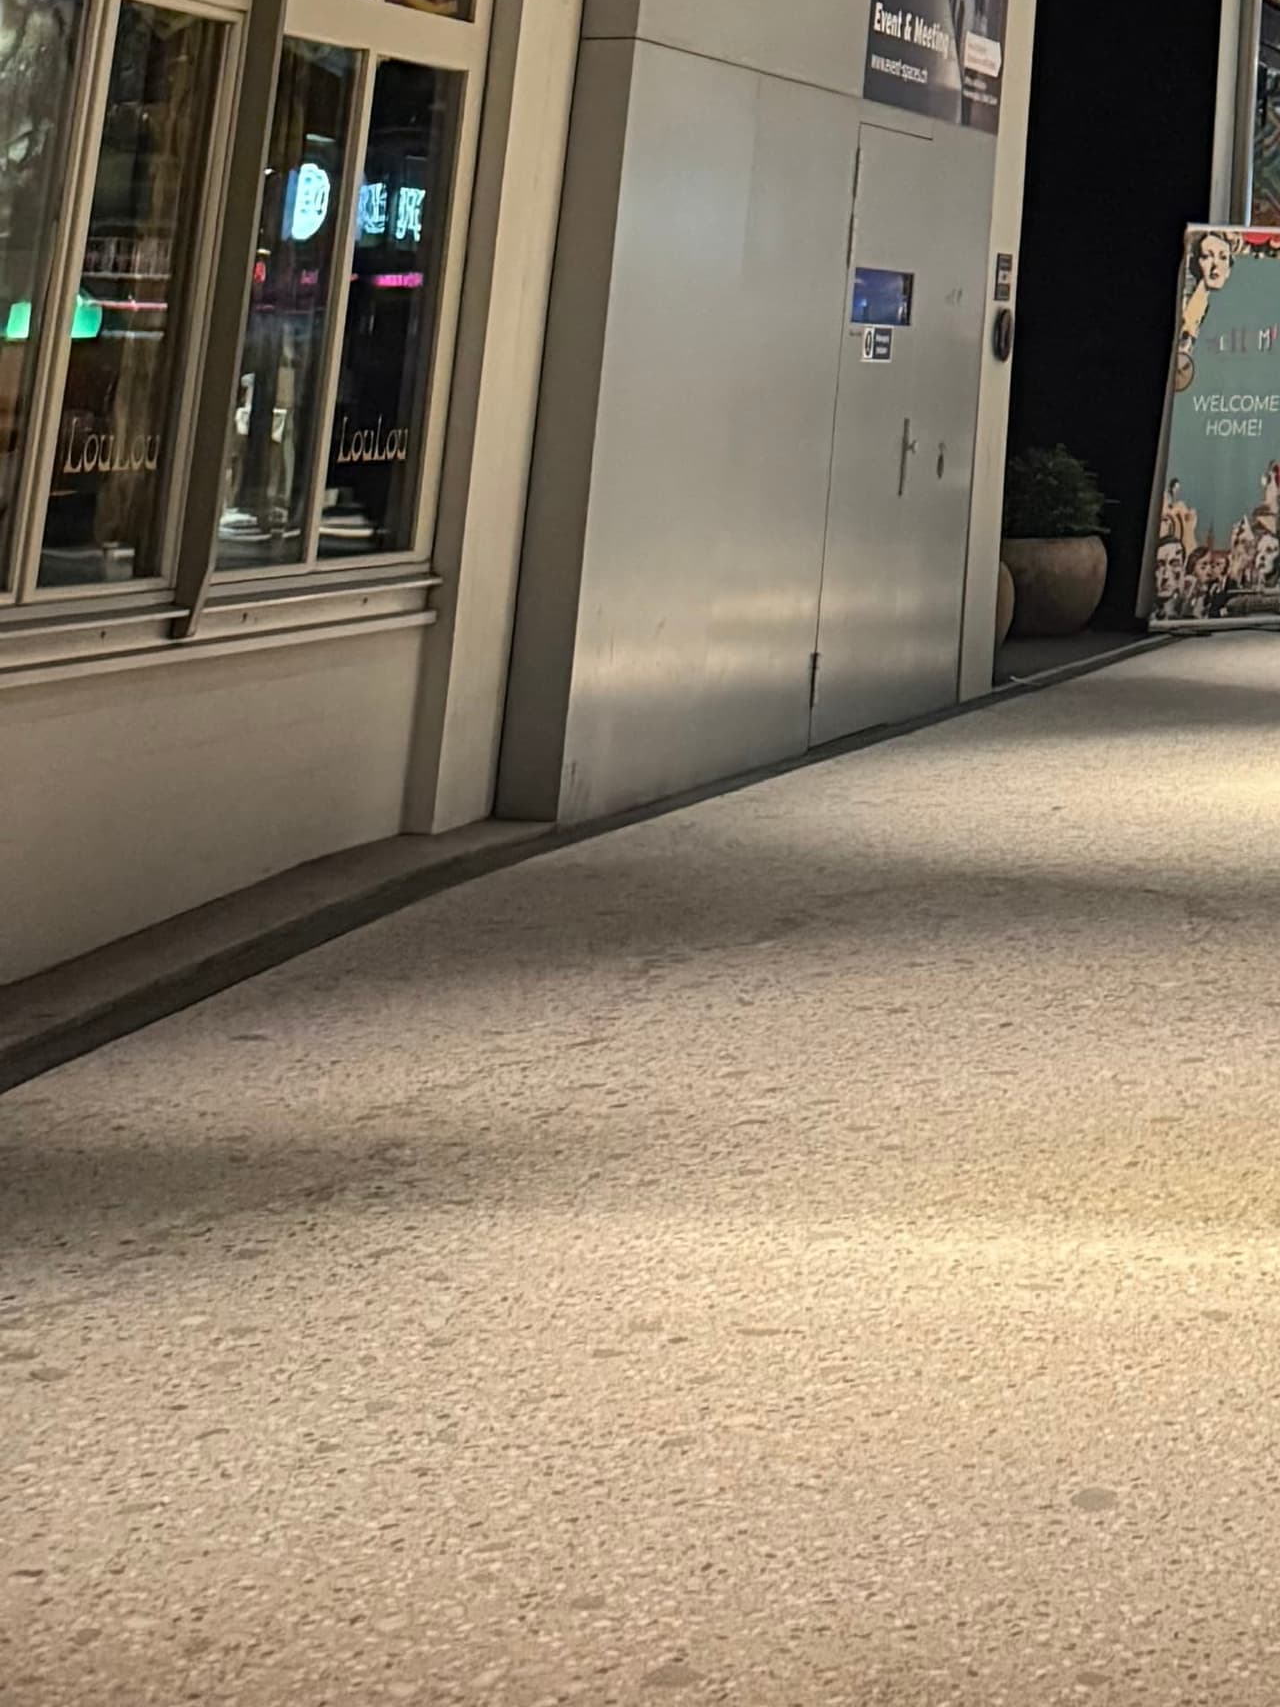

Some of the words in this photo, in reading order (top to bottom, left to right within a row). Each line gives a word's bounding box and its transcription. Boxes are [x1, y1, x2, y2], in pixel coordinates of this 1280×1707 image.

[873, 2, 902, 38] Event
[904, 13, 912, 42] &
[1192, 394, 1280, 412] WELCOME
[1206, 418, 1263, 436] HOME!
